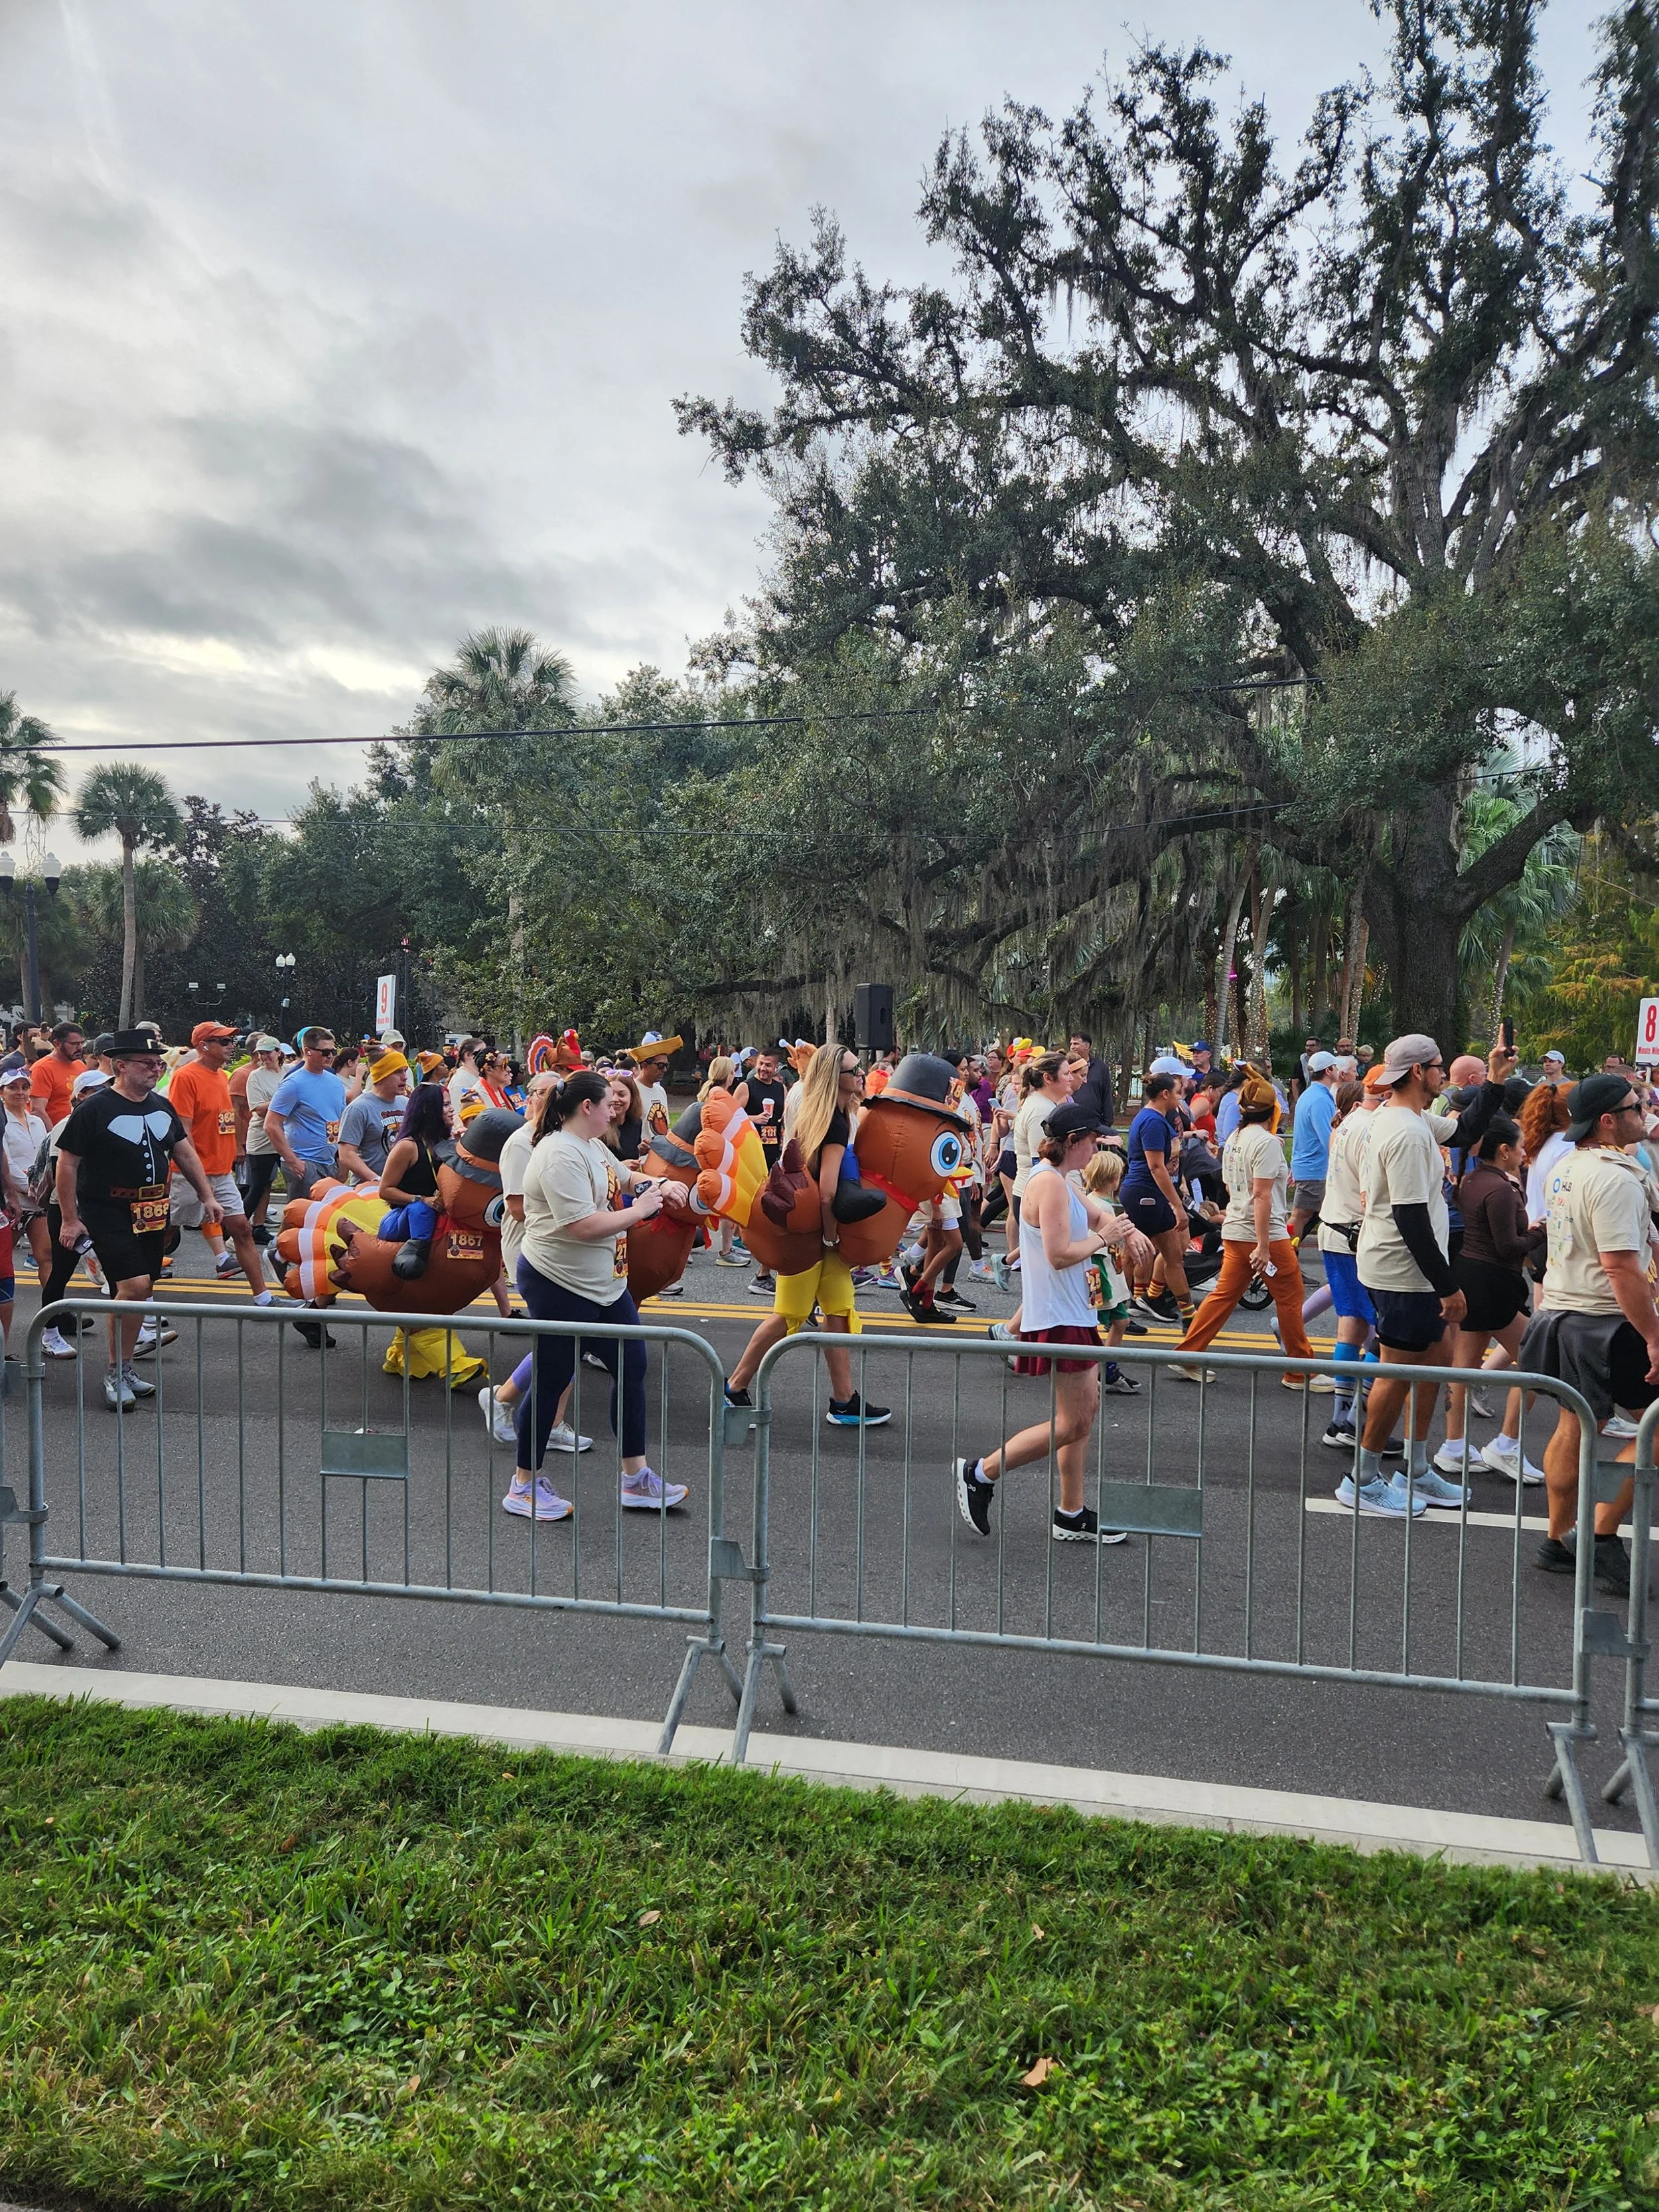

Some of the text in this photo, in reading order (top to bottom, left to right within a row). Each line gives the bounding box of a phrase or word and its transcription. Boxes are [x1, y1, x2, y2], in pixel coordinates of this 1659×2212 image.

[382, 982, 388, 1014] 9
[1645, 1004, 1657, 1043] 8
[450, 1233, 483, 1247] 1867
